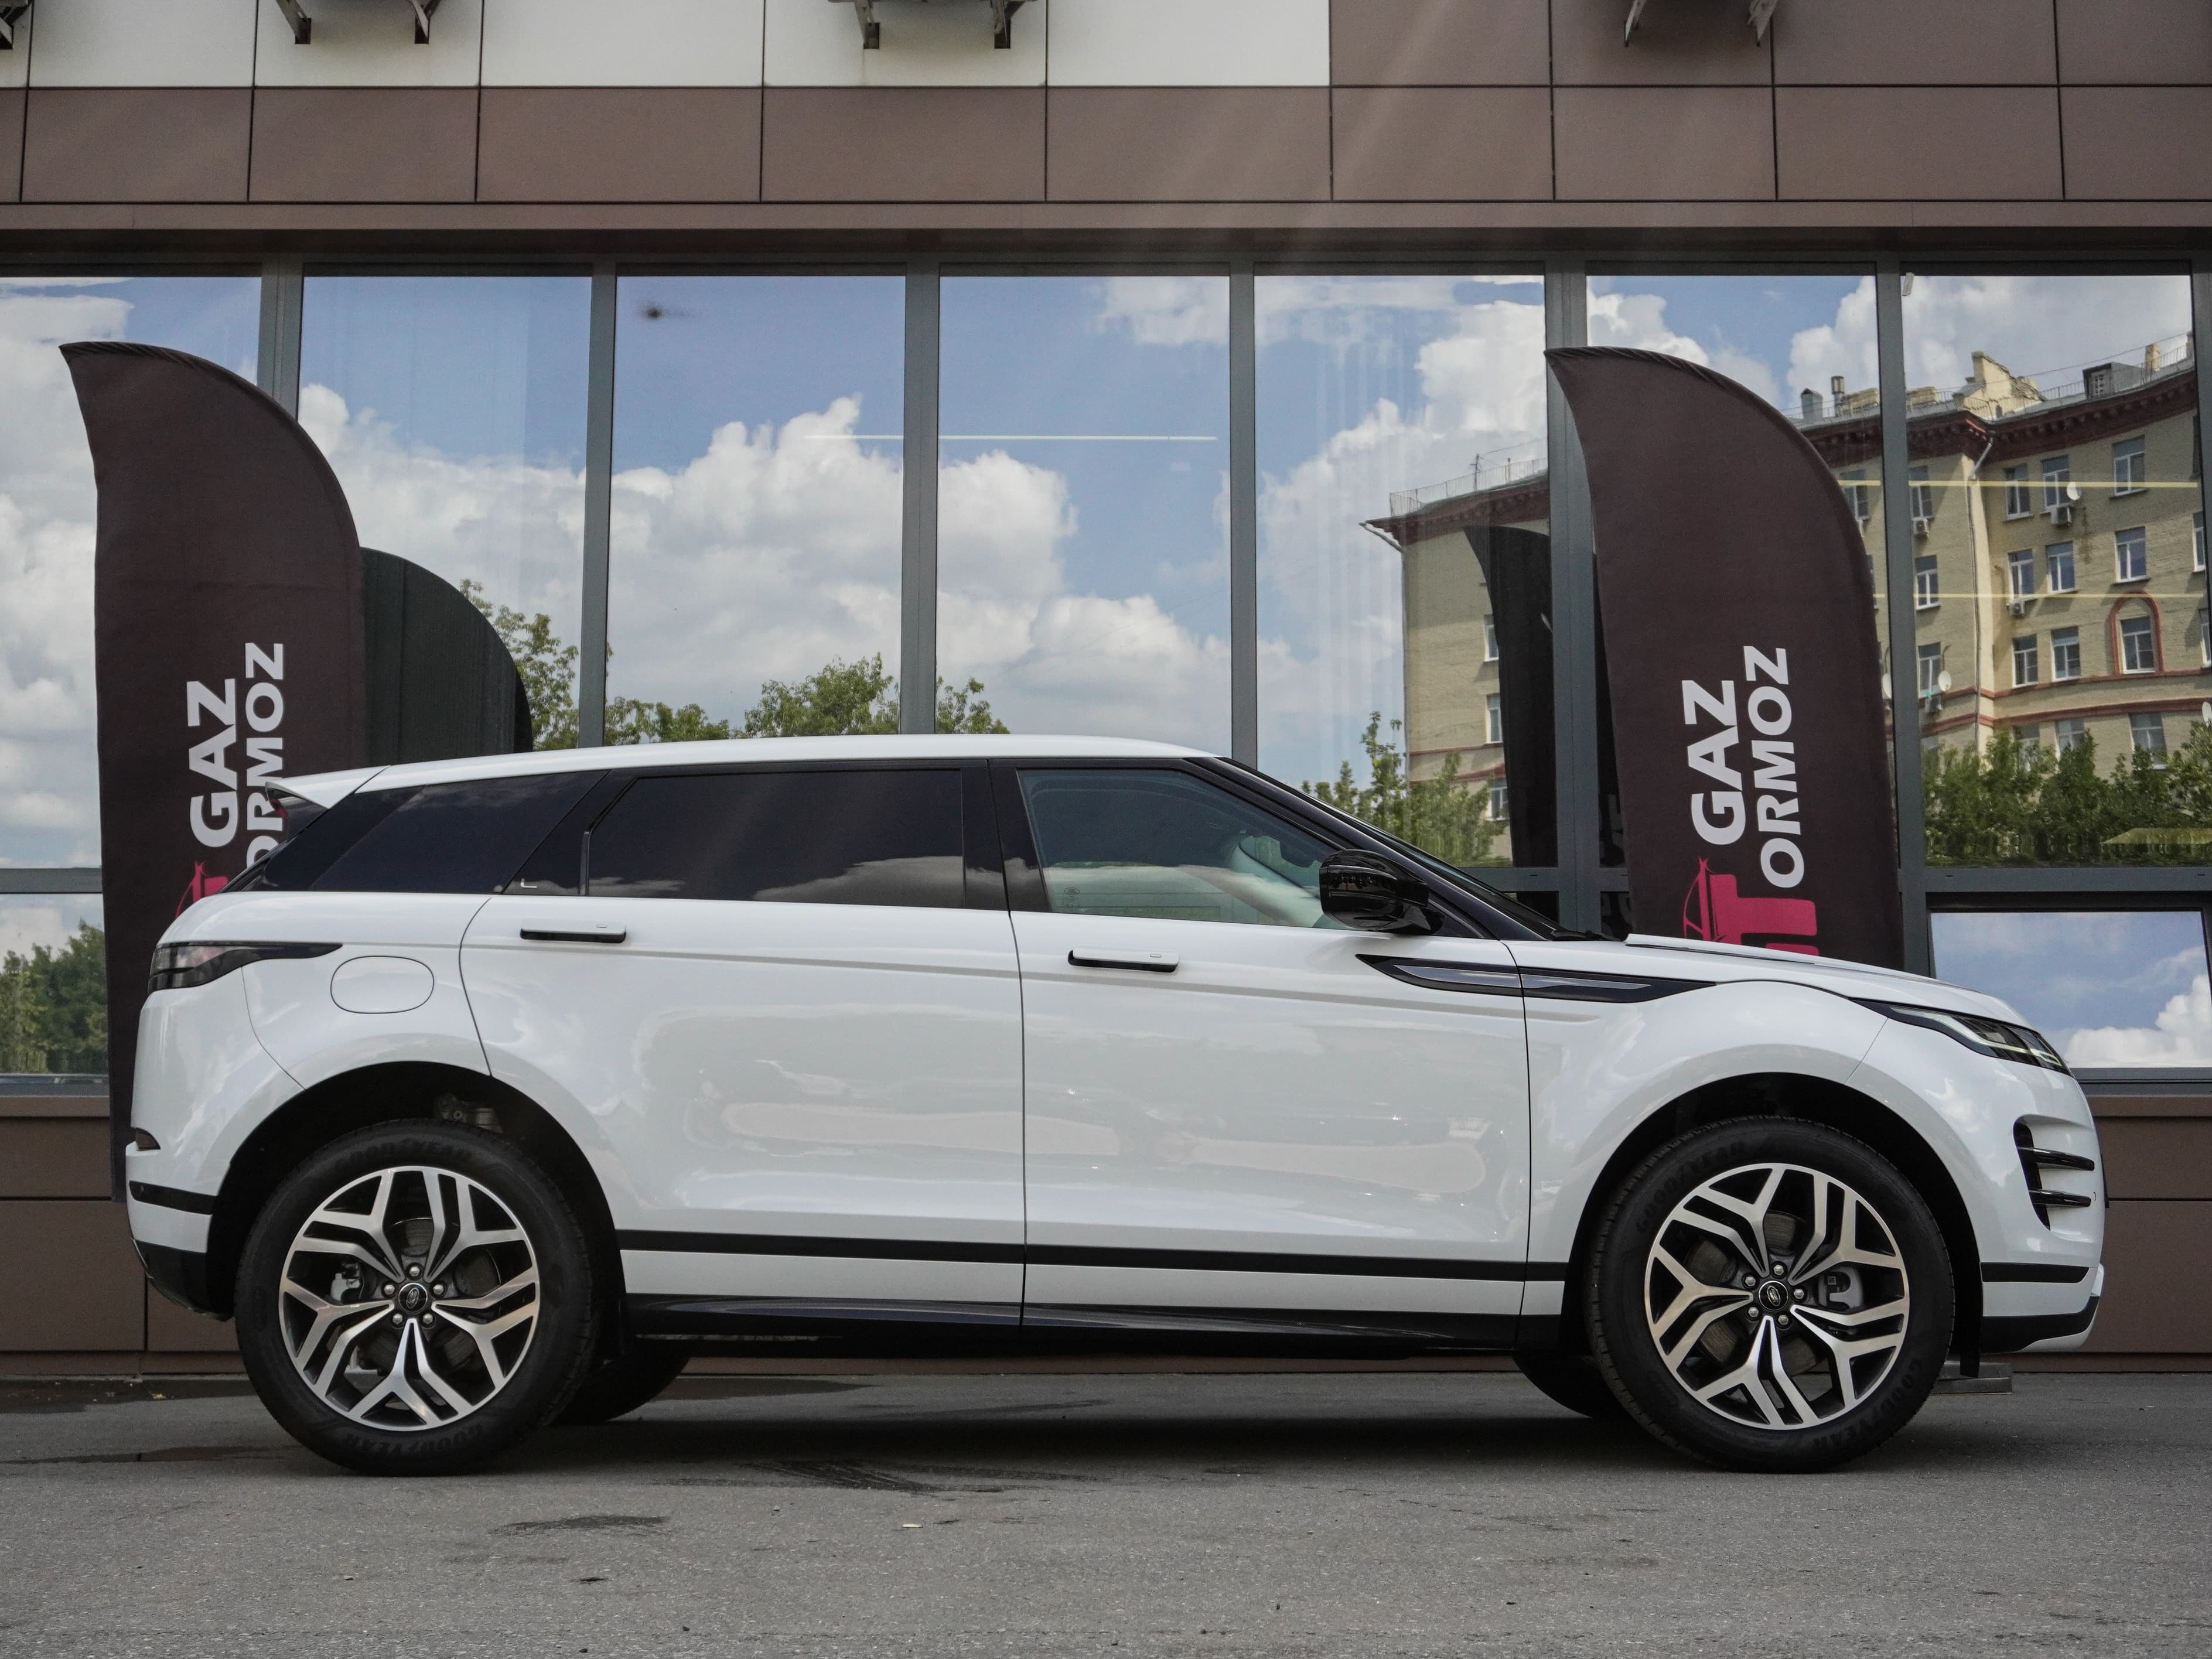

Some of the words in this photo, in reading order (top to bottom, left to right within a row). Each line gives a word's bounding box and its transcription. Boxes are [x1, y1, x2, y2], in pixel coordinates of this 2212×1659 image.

[187, 679, 238, 847] GAZ
[1682, 680, 1746, 845] GAZ
[1743, 646, 1804, 888] ORMOZ
